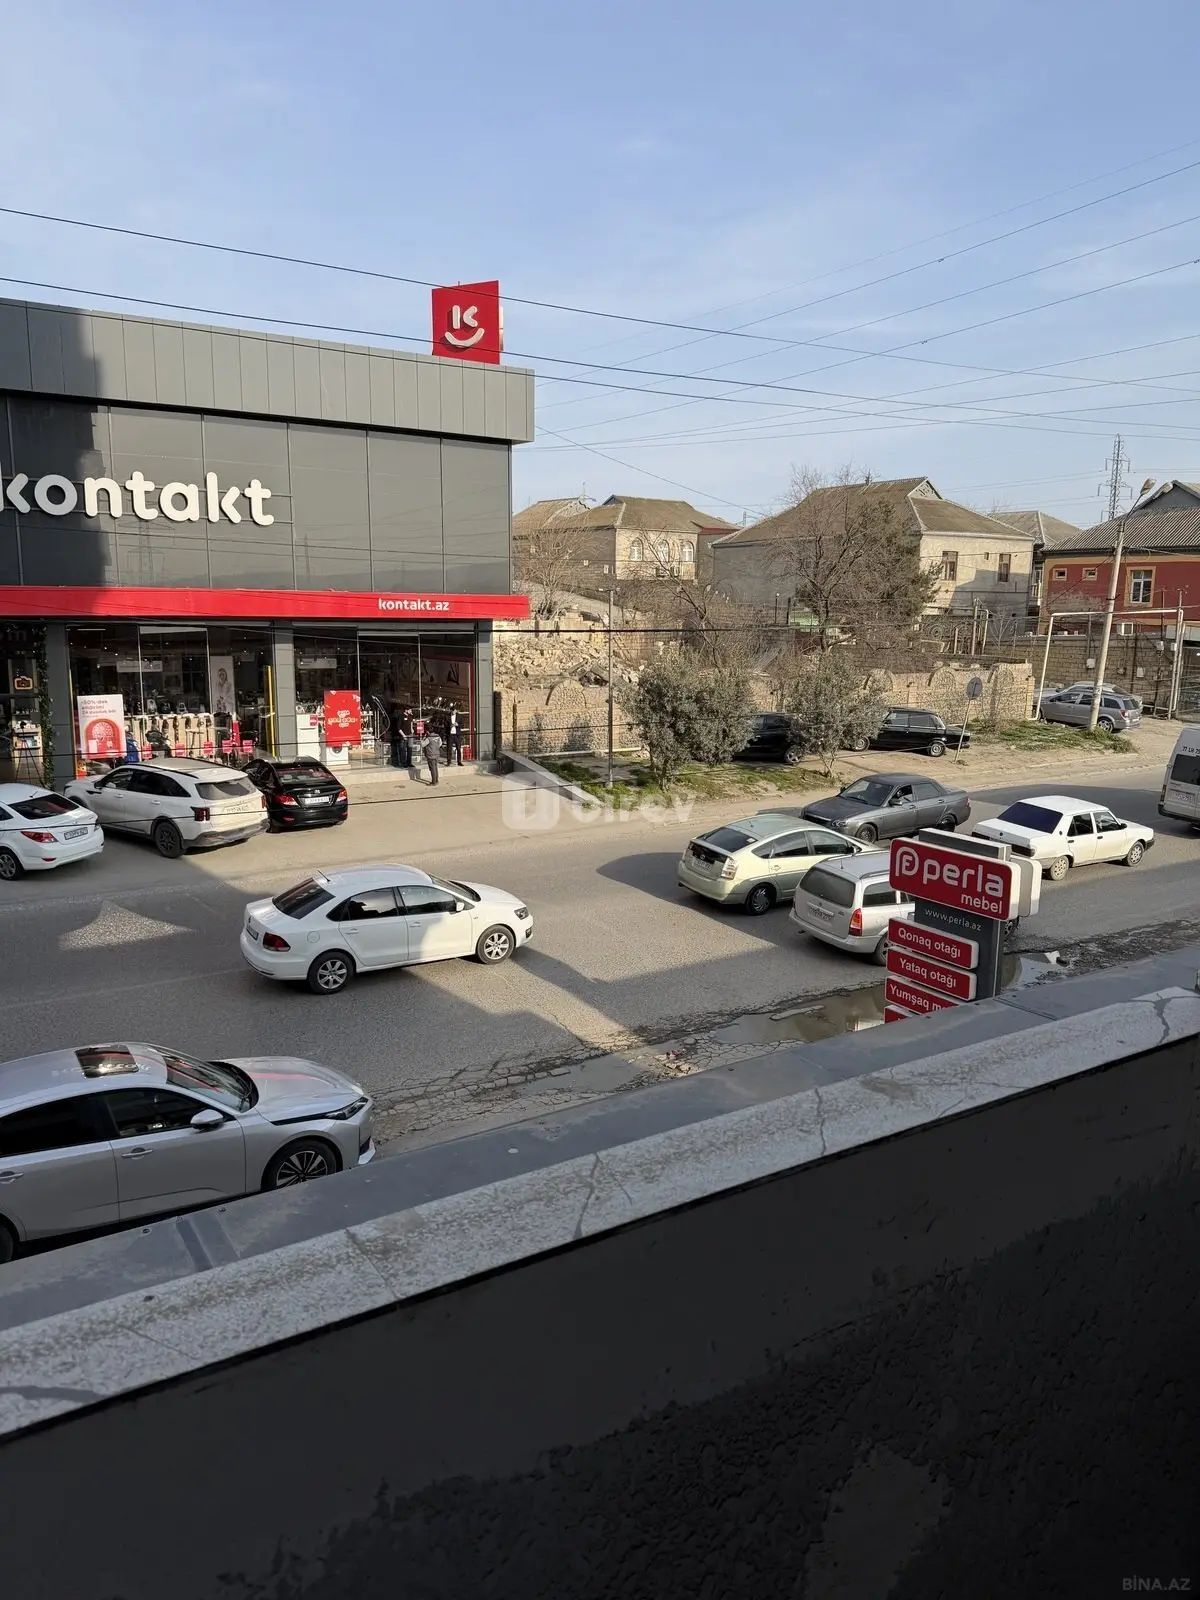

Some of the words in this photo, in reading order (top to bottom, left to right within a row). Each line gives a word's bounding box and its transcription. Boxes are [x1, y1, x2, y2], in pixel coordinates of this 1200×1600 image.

[0, 461, 274, 526] kontakt
[378, 598, 450, 611] kontakt.az
[923, 859, 1004, 898] perla
[961, 894, 1002, 915] mebel
[925, 908, 982, 931] www.perla.az
[898, 928, 931, 949] Qonaq
[934, 940, 961, 958] otağı
[899, 958, 927, 978] Yataq
[930, 969, 956, 987] otağı
[889, 984, 929, 1011] Yumşaq
